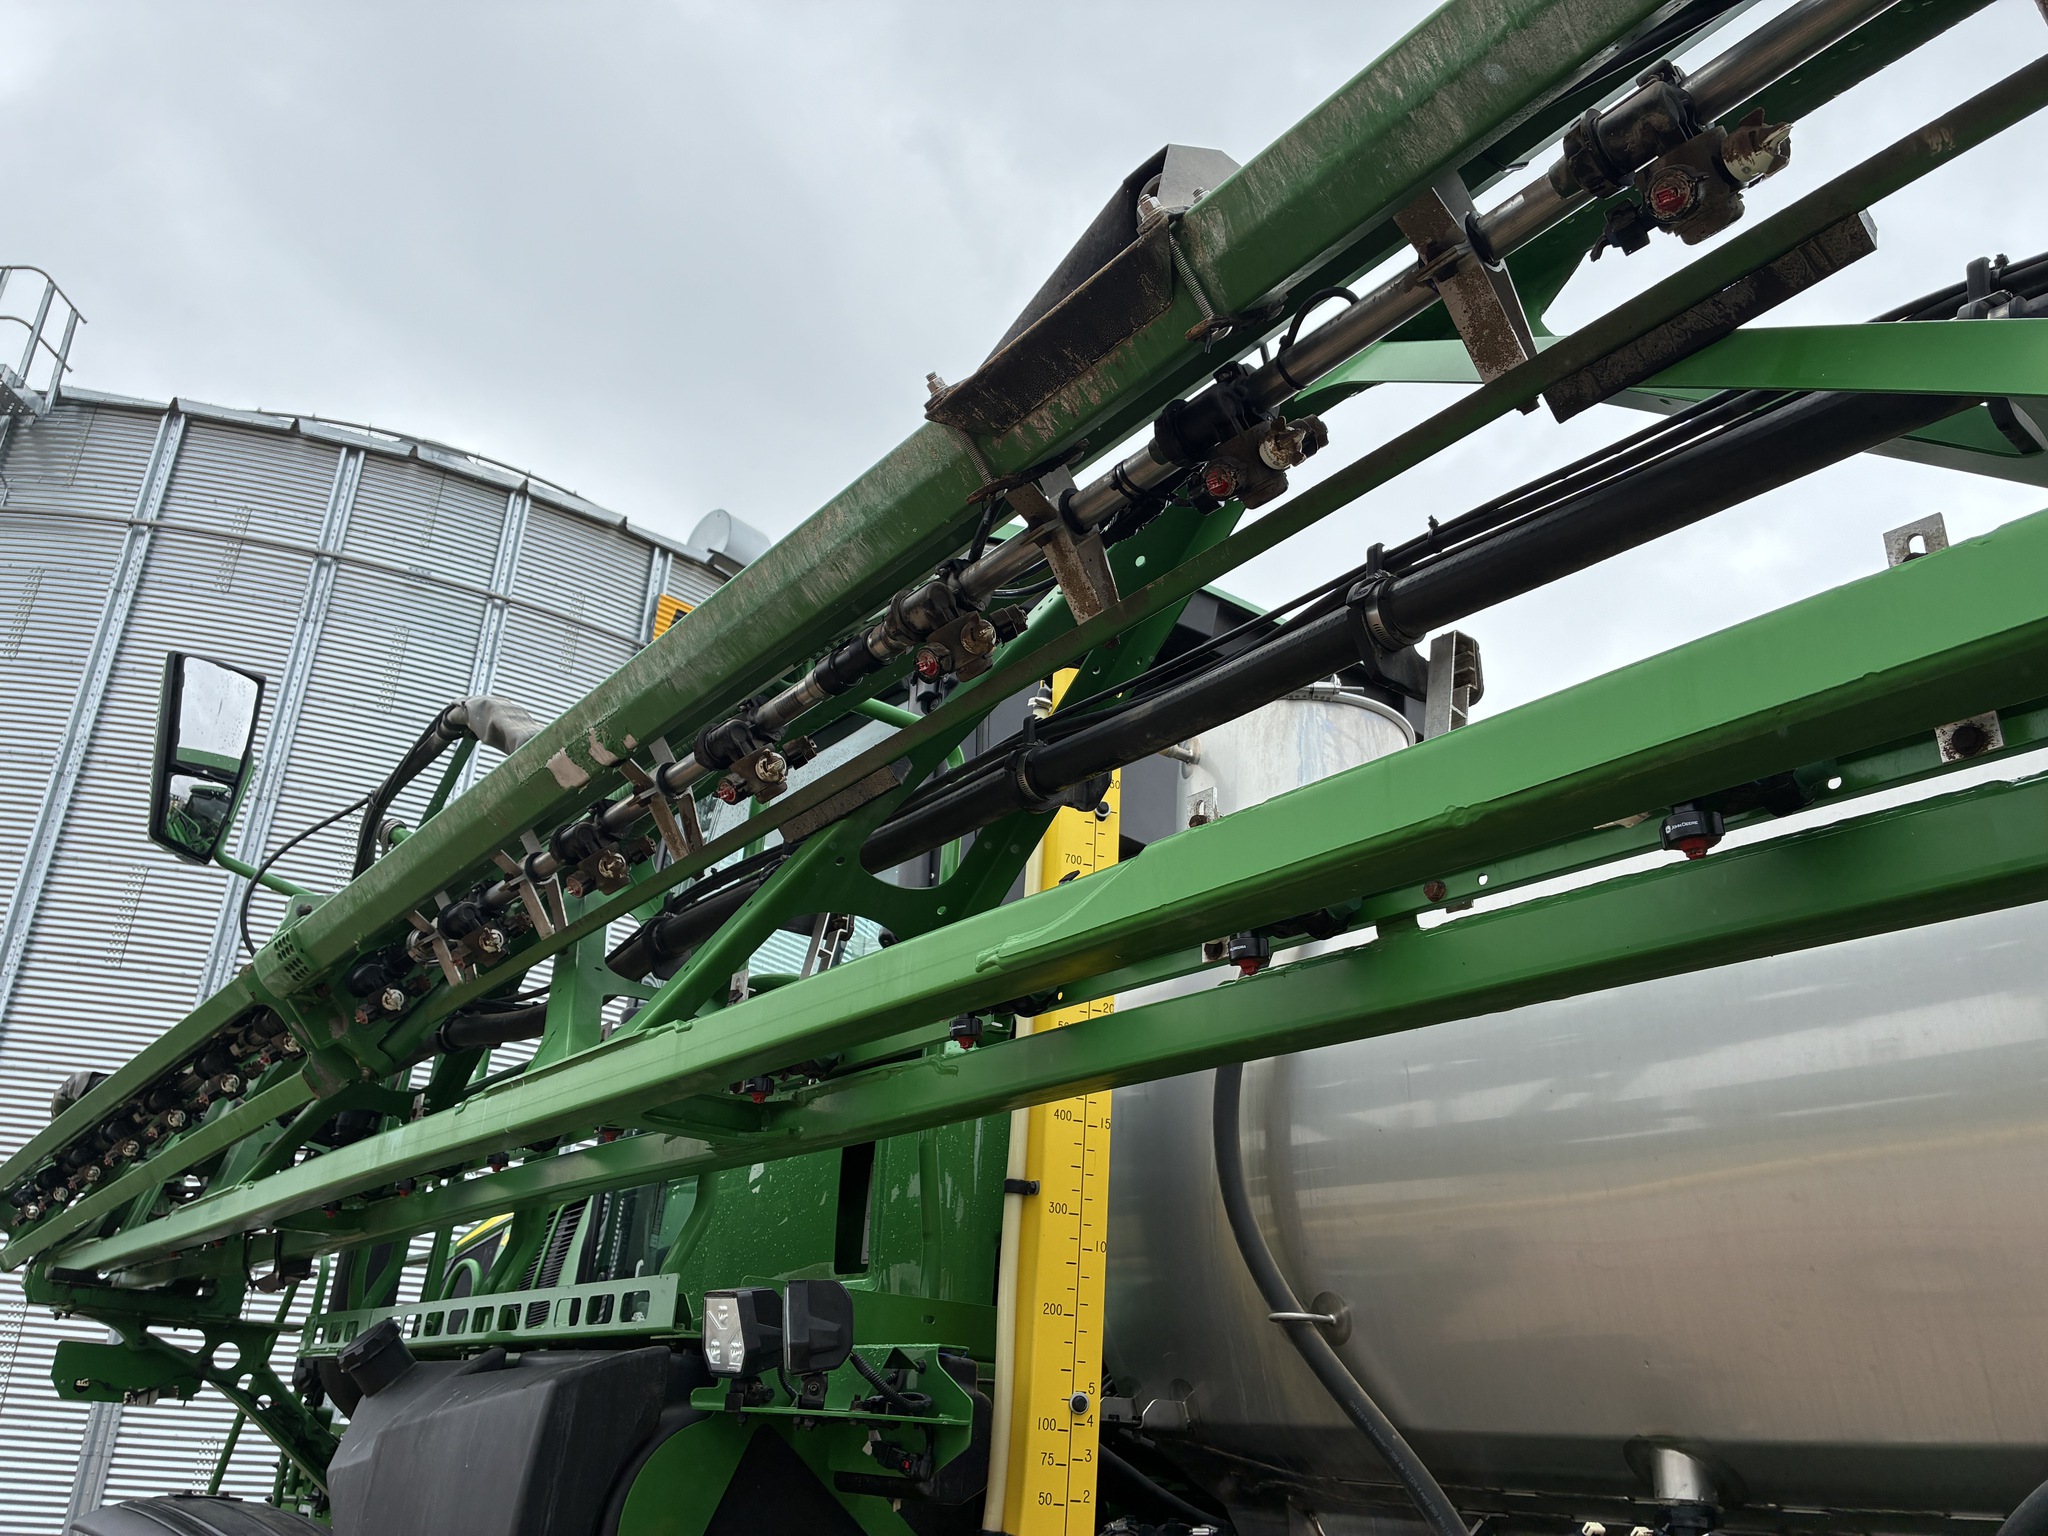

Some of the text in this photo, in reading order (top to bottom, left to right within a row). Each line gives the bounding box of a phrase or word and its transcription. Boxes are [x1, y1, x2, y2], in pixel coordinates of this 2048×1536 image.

[1065, 853, 1082, 865] 700
[1103, 1002, 1115, 1014] 20
[1053, 1108, 1072, 1122] 400
[1100, 1117, 1111, 1130] 15
[1048, 1201, 1068, 1215] 300
[1095, 1240, 1107, 1253] 10
[1043, 1302, 1063, 1316] 200
[1088, 1382, 1095, 1395] 5
[1037, 1417, 1057, 1431] 100
[1086, 1414, 1094, 1428] 4
[1040, 1452, 1055, 1466] 75
[1084, 1449, 1092, 1463] 3
[1038, 1491, 1053, 1506] 50
[1083, 1489, 1091, 1504] 2
